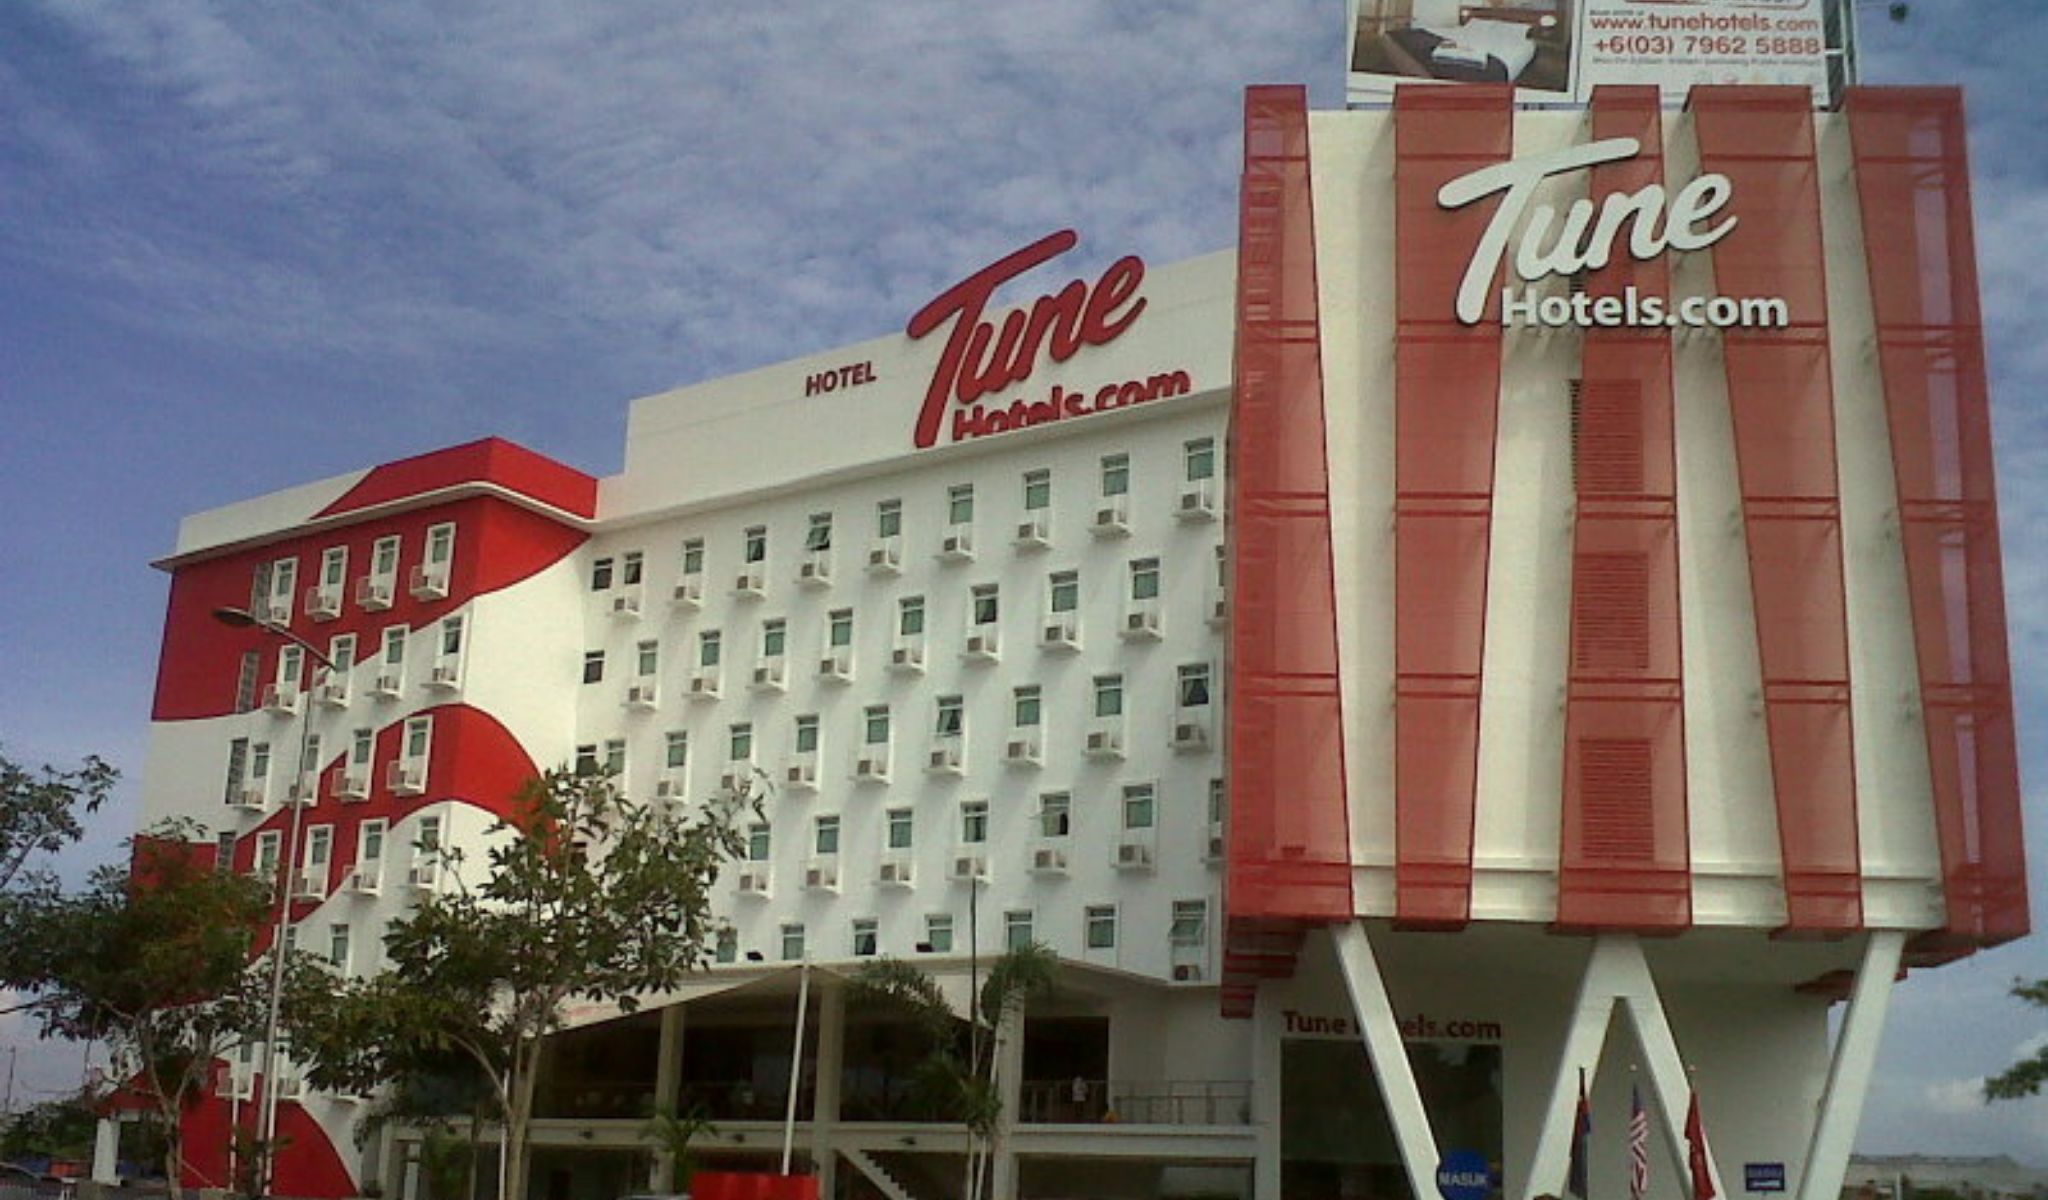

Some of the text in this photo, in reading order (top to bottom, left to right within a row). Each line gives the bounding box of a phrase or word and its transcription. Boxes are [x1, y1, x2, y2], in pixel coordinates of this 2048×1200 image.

[1594, 35, 1820, 55] +6(03) 7962 5888
[1437, 137, 1738, 324] Tune
[1501, 286, 1789, 327] Hotels.com
[907, 229, 1147, 448] Tune
[806, 361, 877, 397] HOTEL
[1282, 1011, 1501, 1038] Tune els.com
